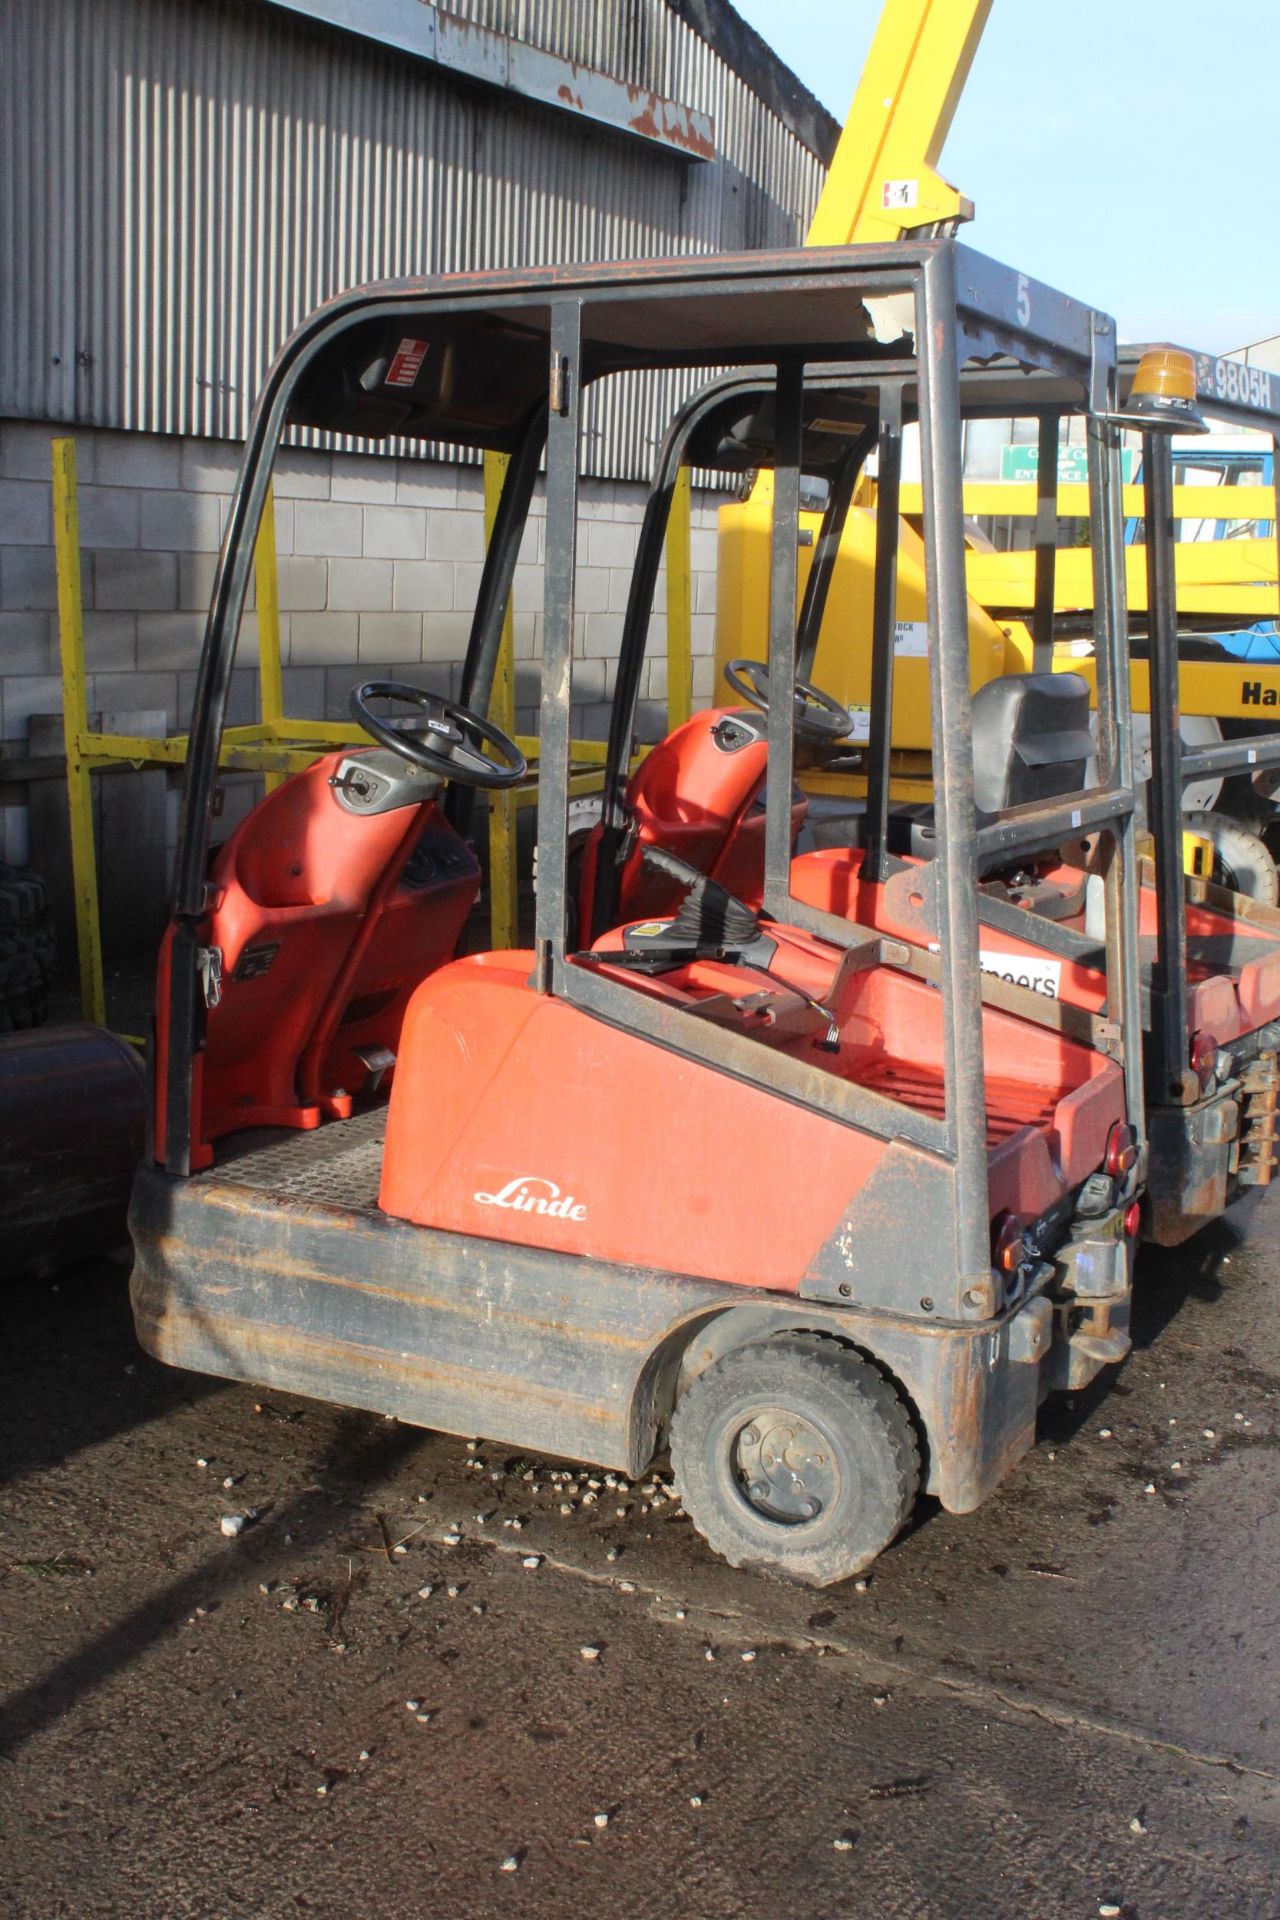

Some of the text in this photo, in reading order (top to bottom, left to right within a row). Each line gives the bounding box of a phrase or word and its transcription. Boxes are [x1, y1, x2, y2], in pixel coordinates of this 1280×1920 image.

[1016, 273, 1030, 327] 5
[1215, 359, 1271, 409] 9805H
[1241, 681, 1280, 706] Ha
[473, 1177, 587, 1221] Linde
